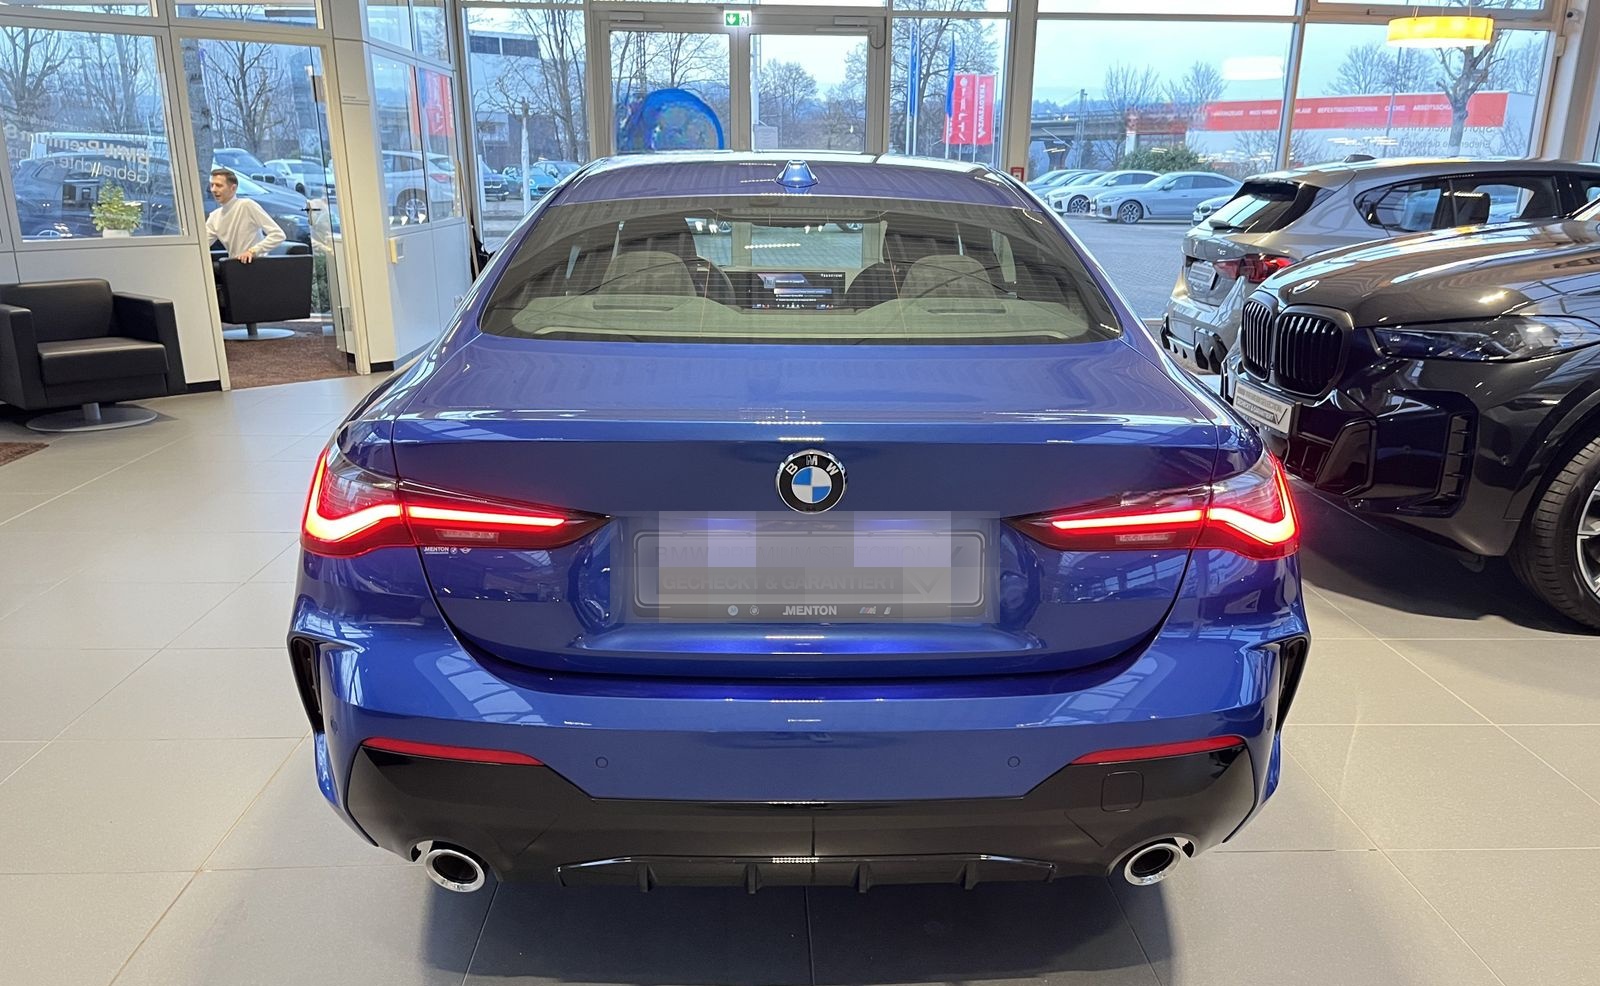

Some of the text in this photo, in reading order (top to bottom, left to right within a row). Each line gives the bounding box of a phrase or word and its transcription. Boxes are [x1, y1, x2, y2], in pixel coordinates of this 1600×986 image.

[785, 455, 839, 476] BMW
[663, 574, 896, 590] GECHECKT & GARANTIERT
[782, 605, 838, 616] MENTON
